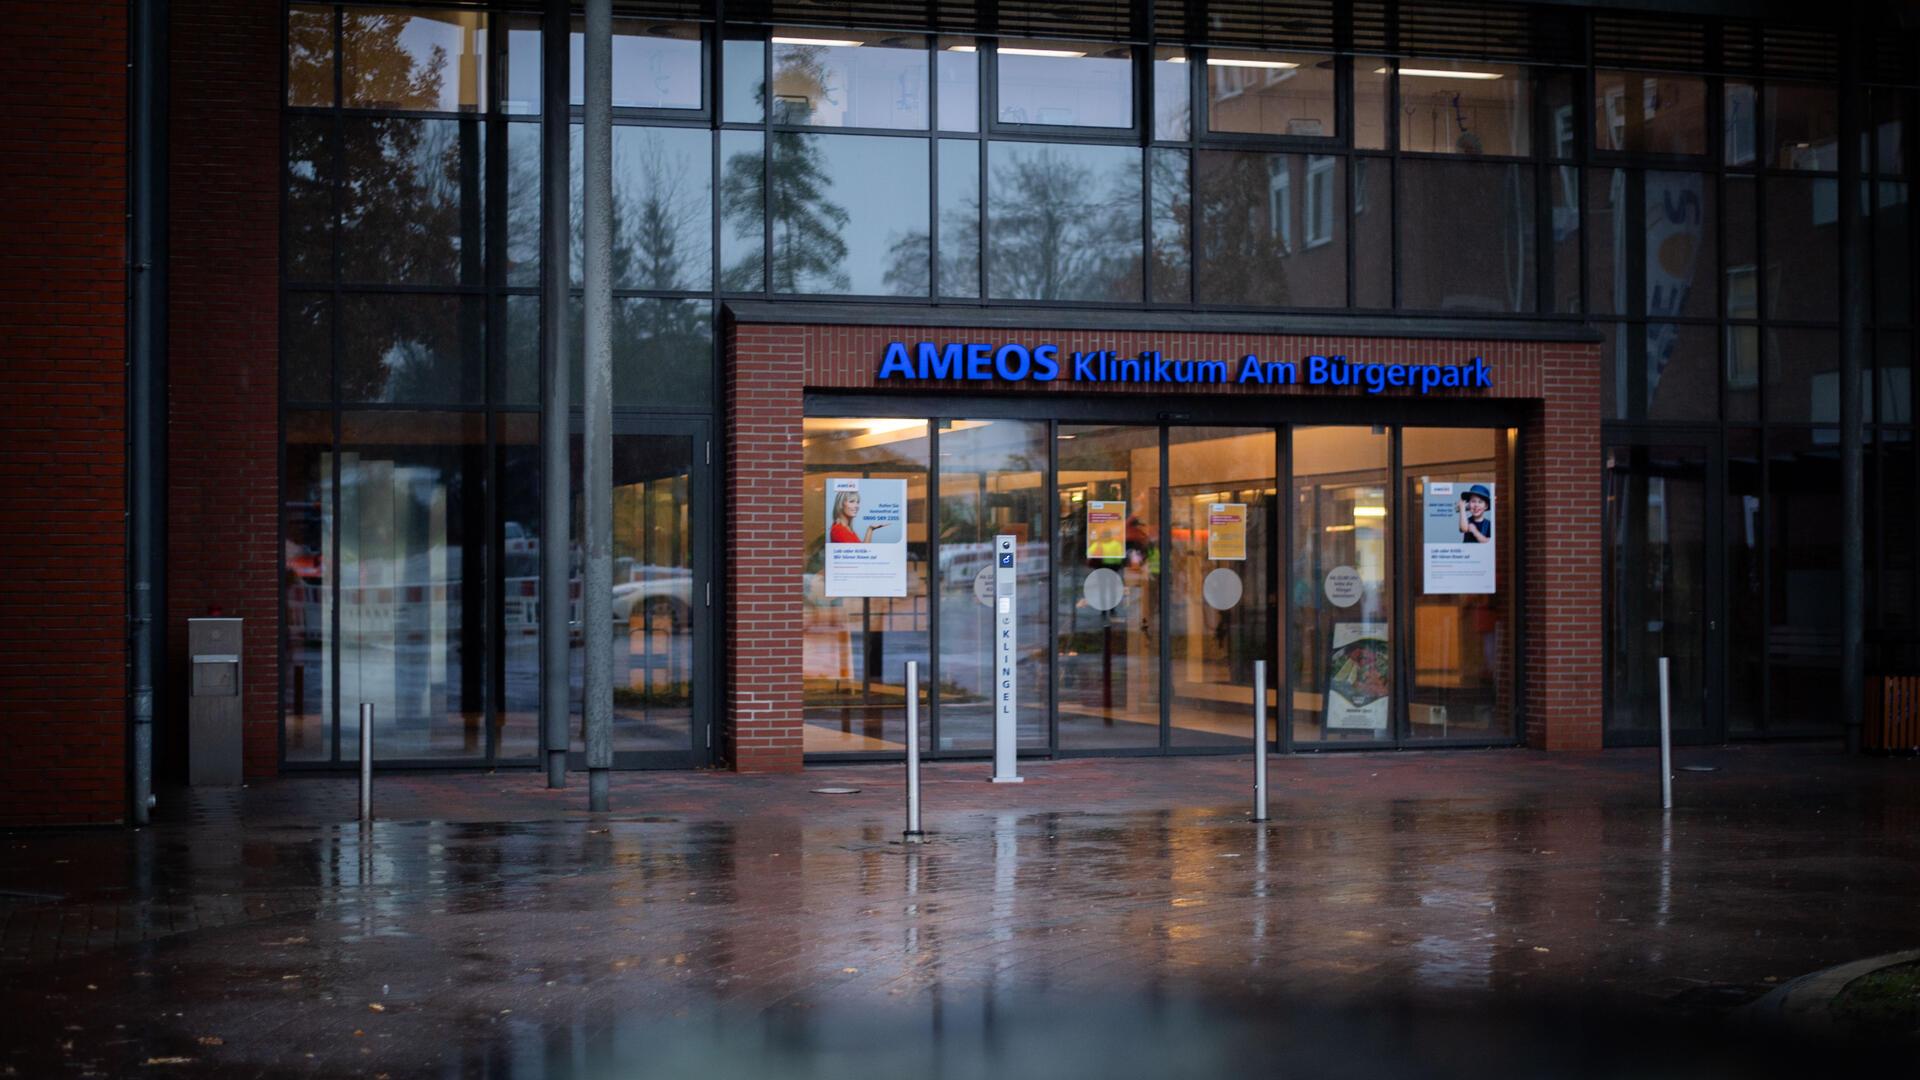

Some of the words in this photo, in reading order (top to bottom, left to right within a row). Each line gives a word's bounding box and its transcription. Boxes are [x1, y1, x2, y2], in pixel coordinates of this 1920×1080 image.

[879, 342, 1060, 382] AMEOS
[1073, 350, 1228, 386] Klinikum
[1239, 354, 1297, 386] Am
[1307, 355, 1492, 395] Bürgerpark
[1002, 629, 1011, 714] KLINGEL
